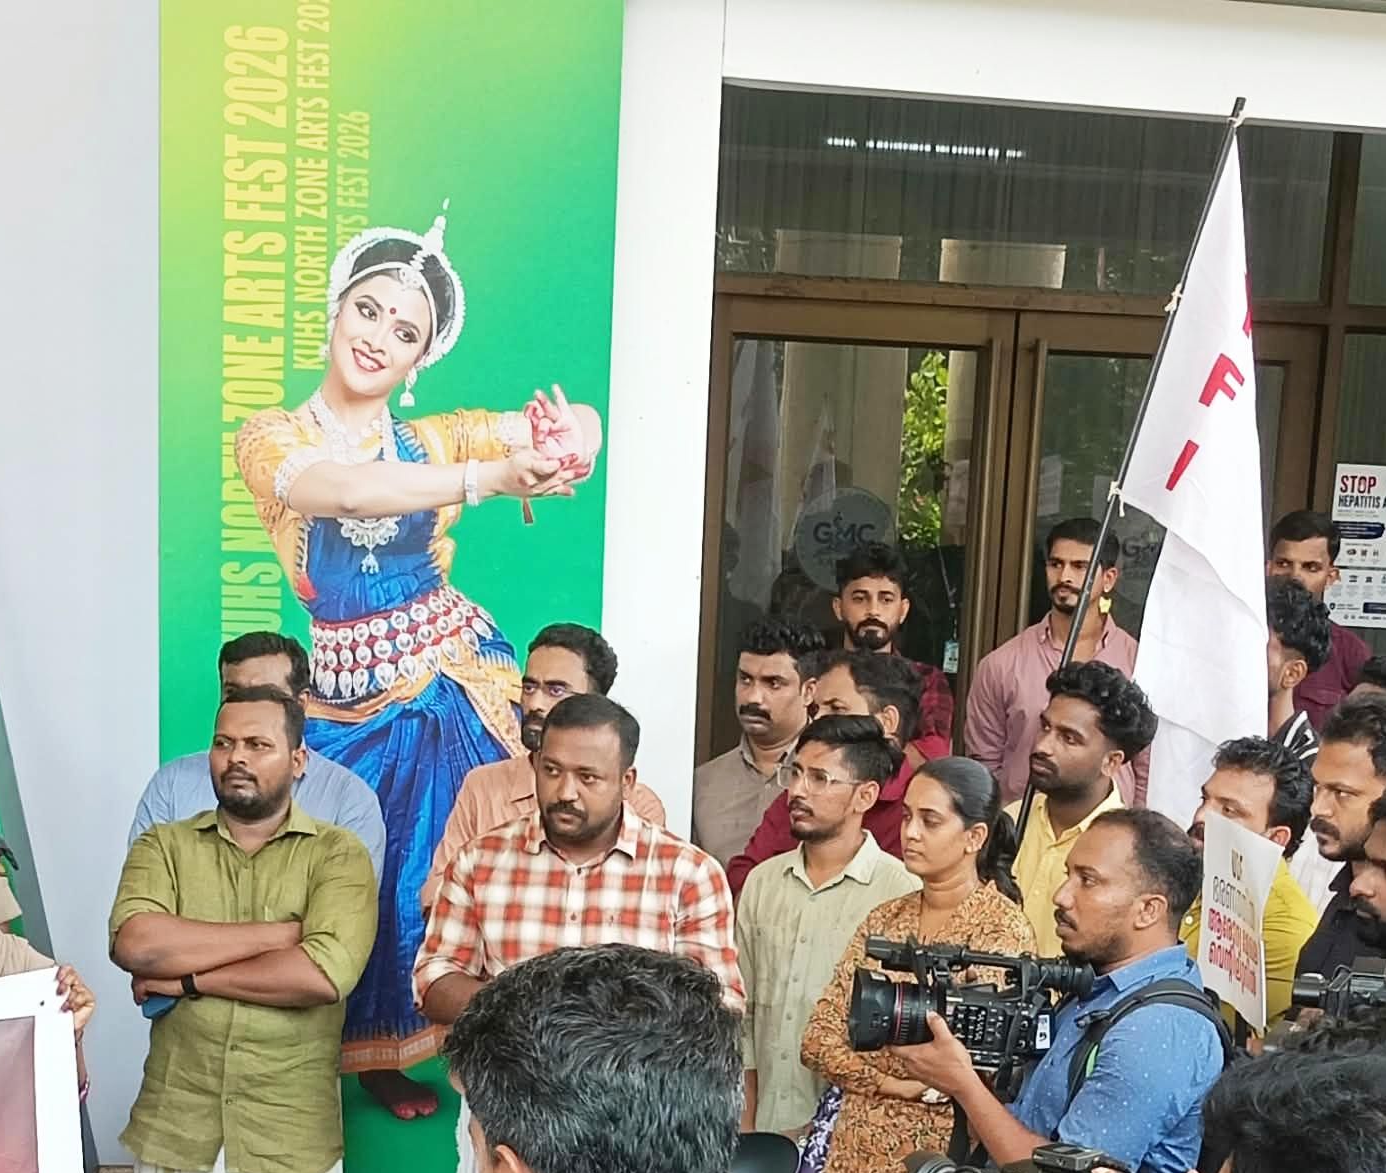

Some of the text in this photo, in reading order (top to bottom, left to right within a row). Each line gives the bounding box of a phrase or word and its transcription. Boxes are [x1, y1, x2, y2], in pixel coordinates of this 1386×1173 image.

[223, 25, 289, 129] 2026
[337, 110, 370, 160] 2026
[223, 134, 288, 223] FEST
[293, 0, 330, 370] KUHS NORTH ZONE ARTS FEST 20
[336, 164, 369, 208] FEST
[222, 230, 288, 329] ARTS
[1338, 495, 1381, 509] HEPATITIS
[1340, 475, 1377, 494] STOP
